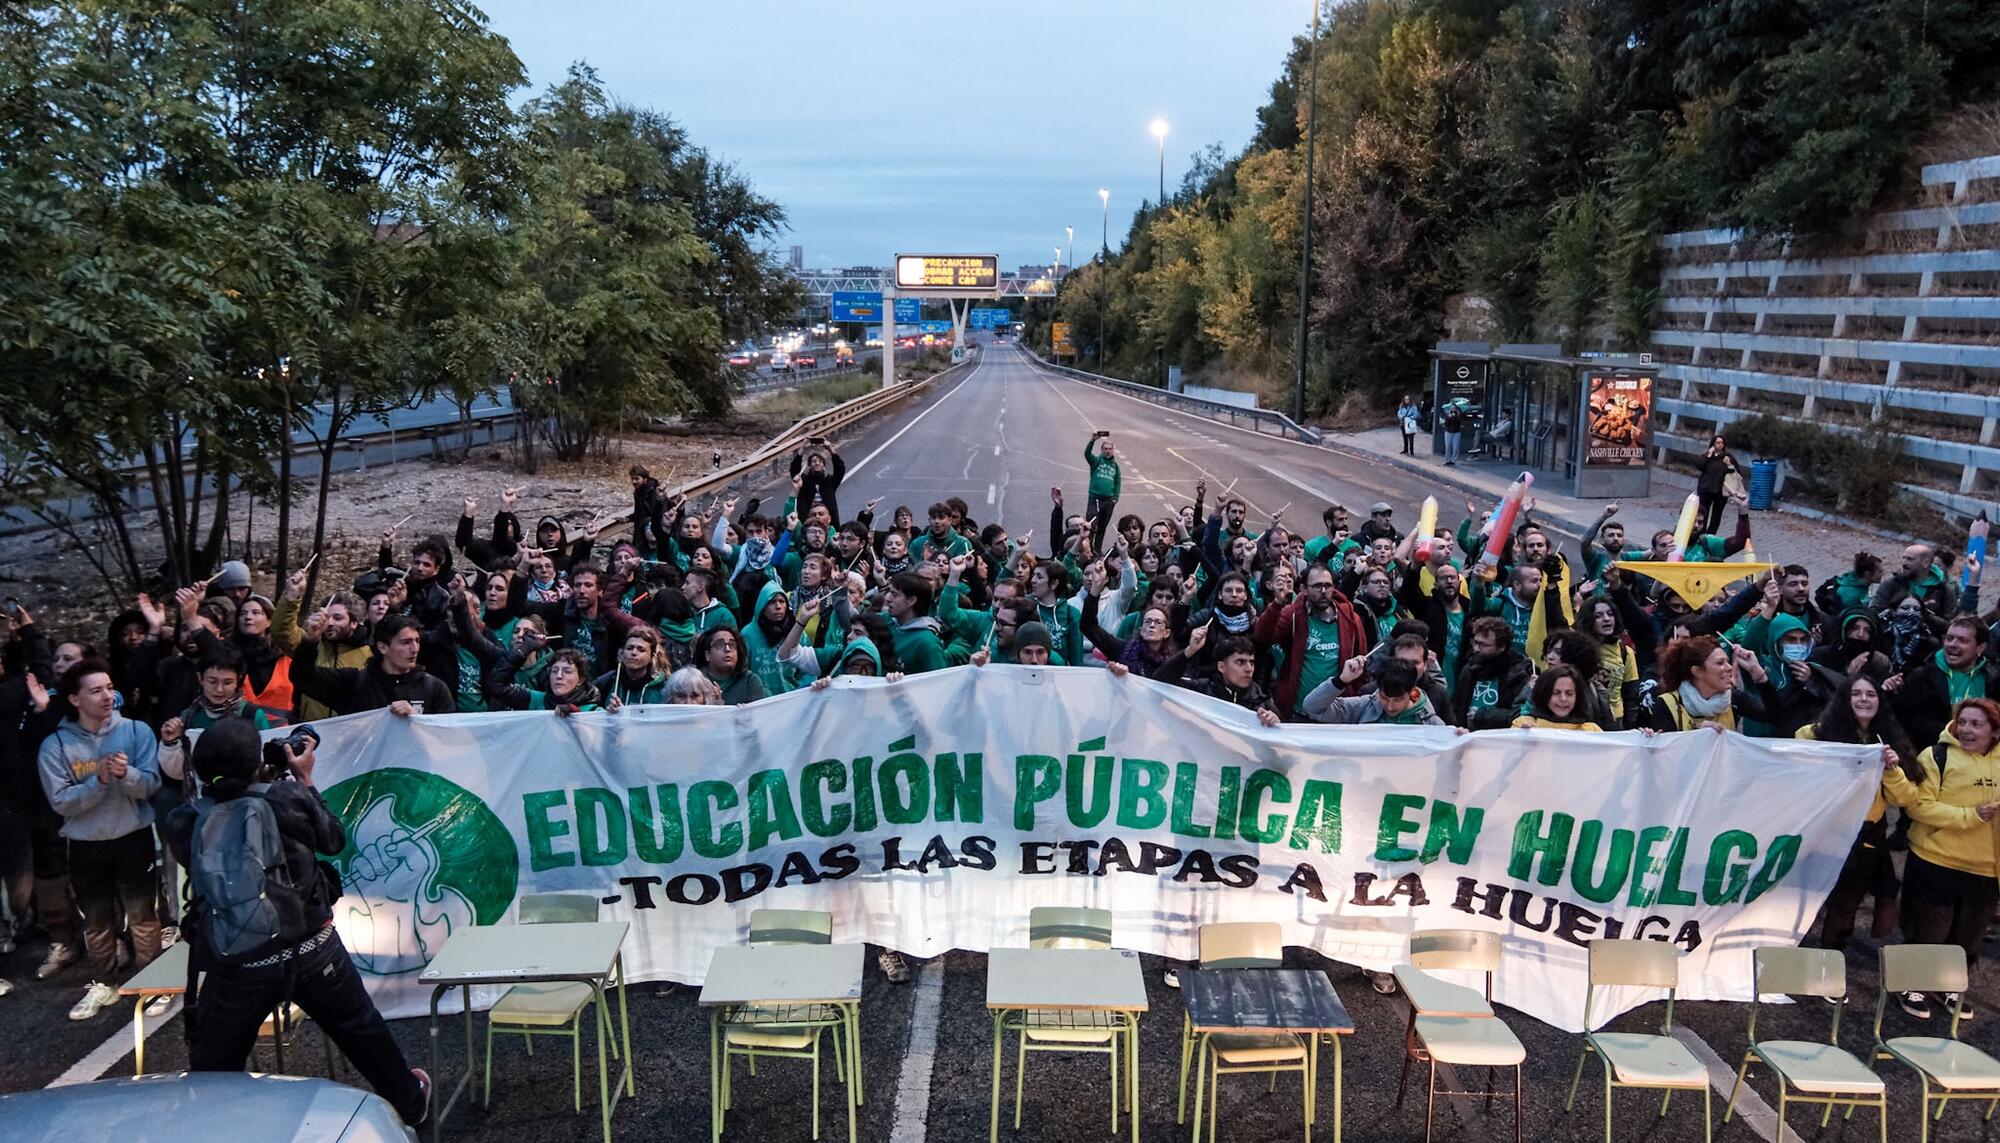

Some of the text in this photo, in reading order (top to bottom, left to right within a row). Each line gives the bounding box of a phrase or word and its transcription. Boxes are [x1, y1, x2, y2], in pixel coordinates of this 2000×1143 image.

[924, 258, 983, 267] PRECAUCION
[925, 267, 994, 276] OBRAS ACCESO
[1589, 447, 1645, 458] NASHVILLE CHICKEN
[1315, 642, 1340, 651] CRID
[523, 734, 1803, 909] EDUCACIÓN PÚBLICA EN HUELGA
[881, 834, 997, 873] LAS
[1019, 836, 1261, 888] ETAPAS
[1278, 862, 1328, 902] A
[1349, 871, 1431, 906] LA
